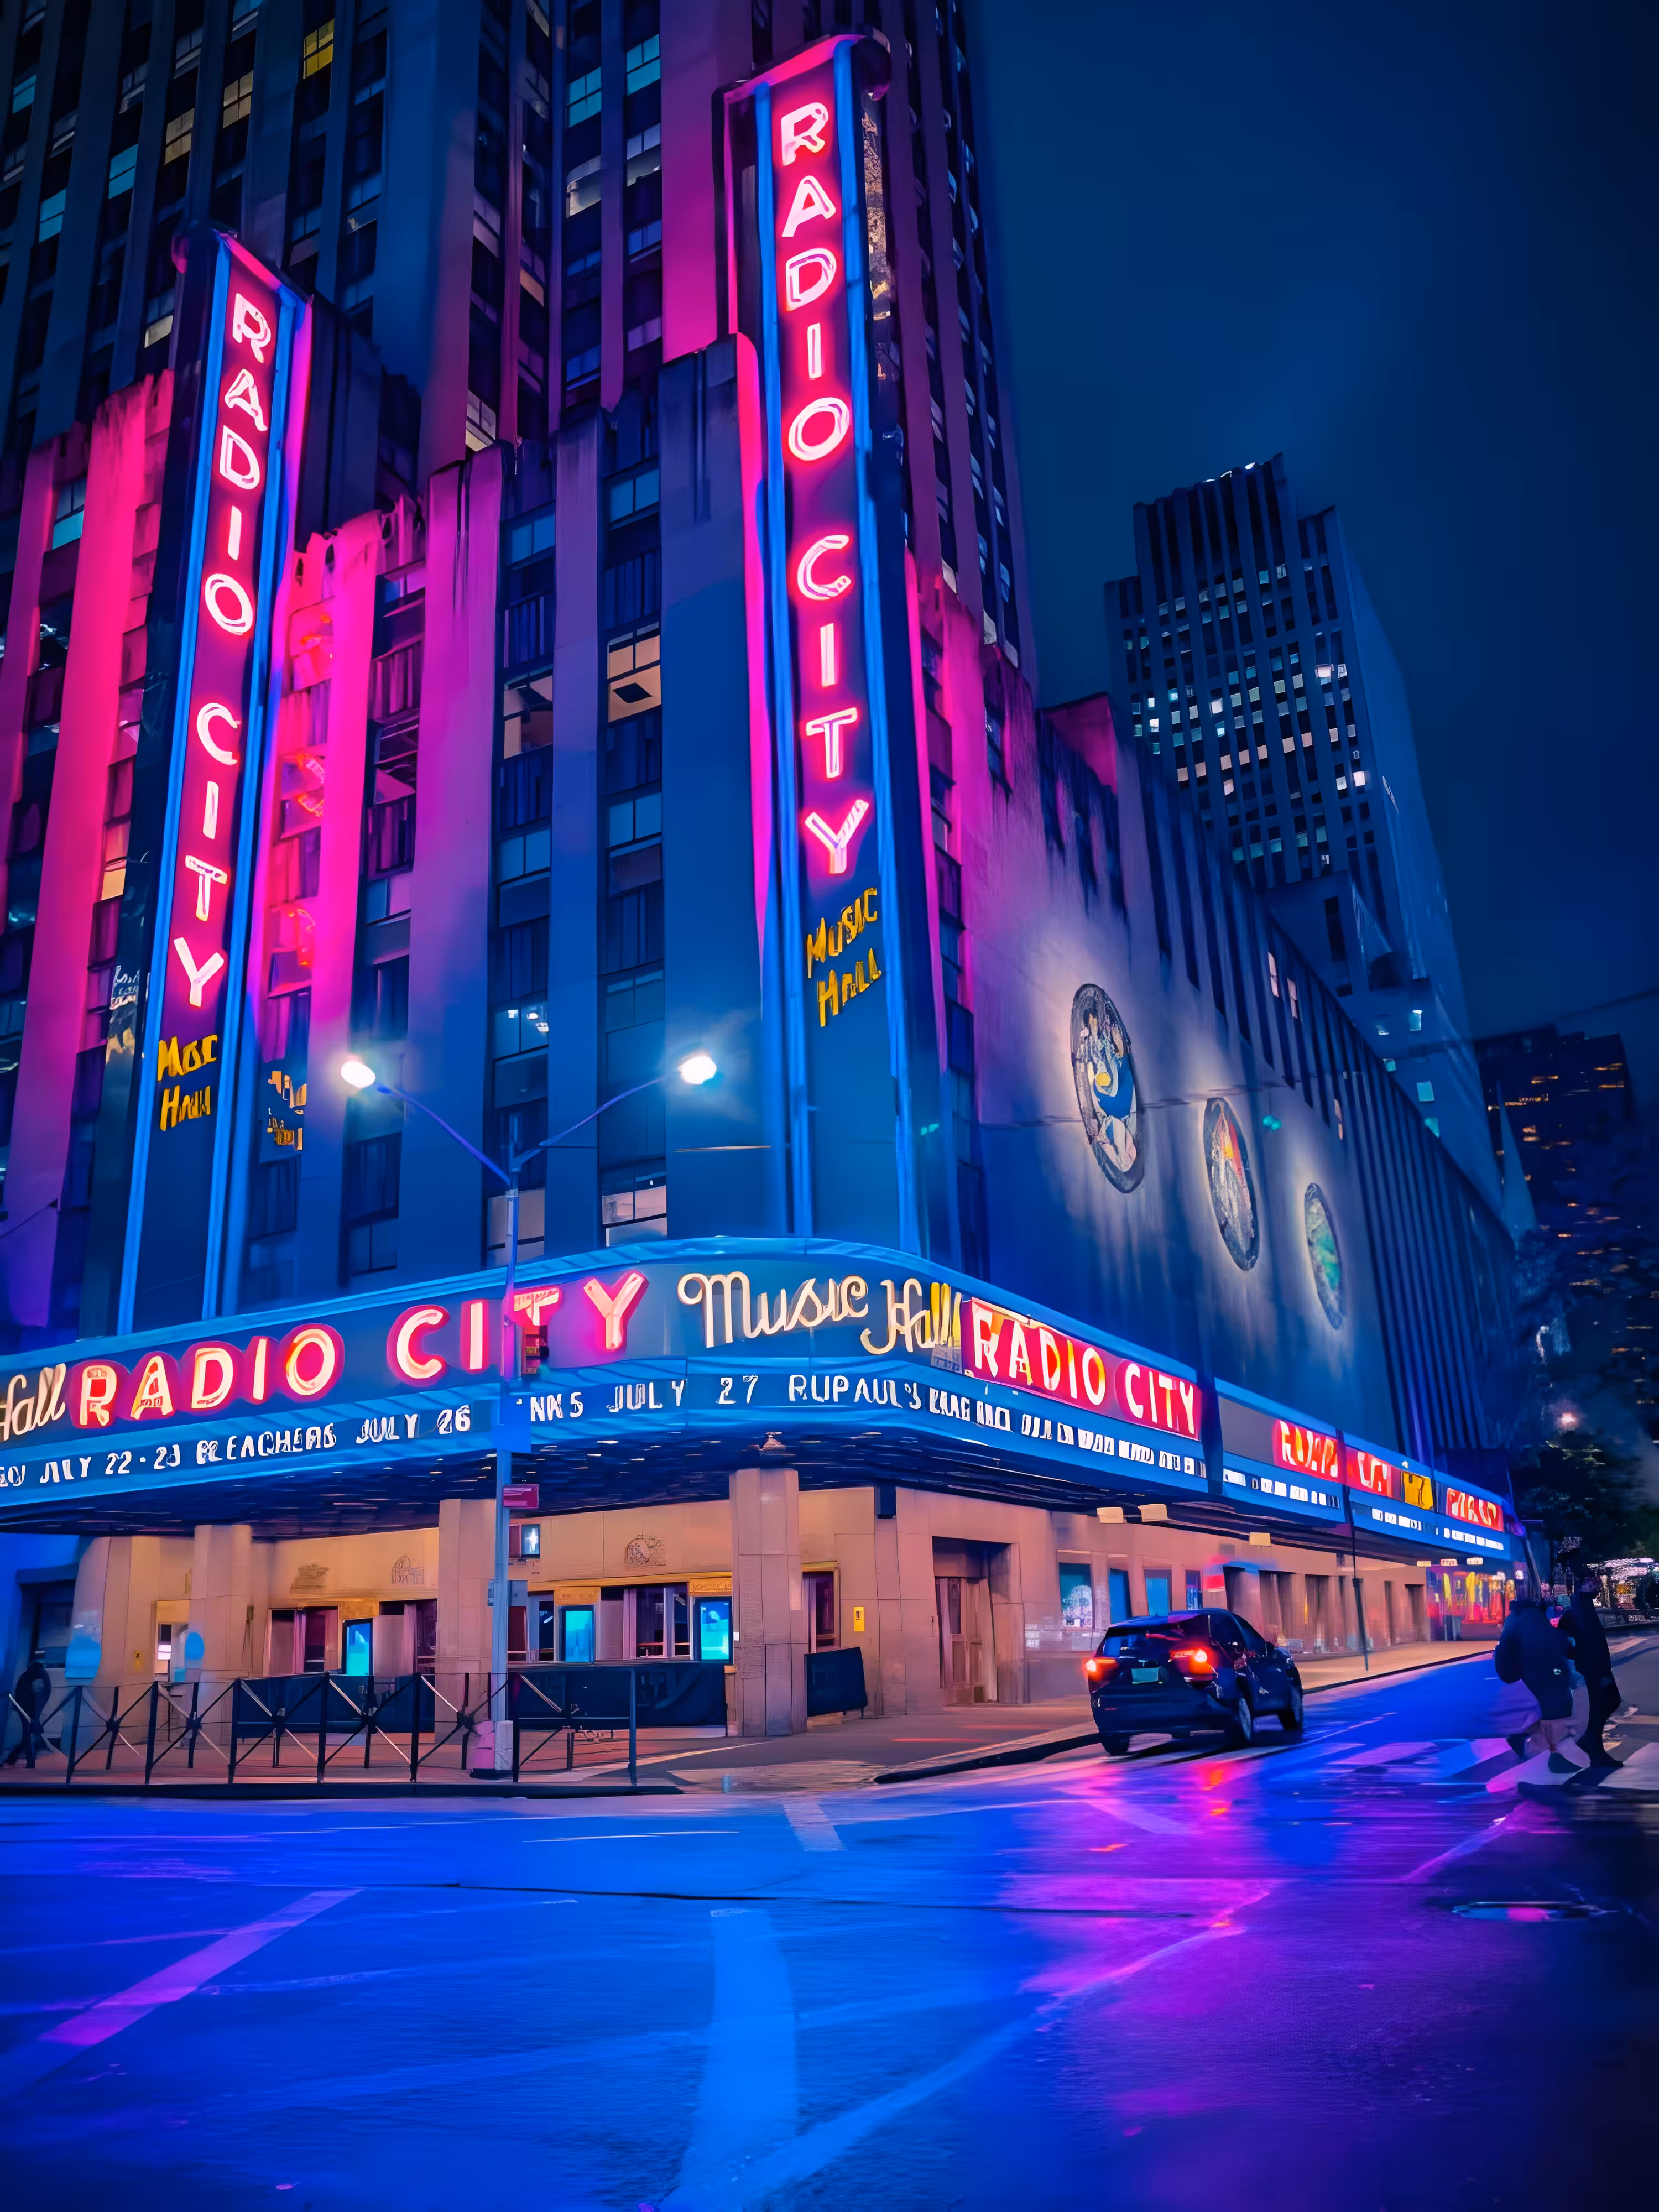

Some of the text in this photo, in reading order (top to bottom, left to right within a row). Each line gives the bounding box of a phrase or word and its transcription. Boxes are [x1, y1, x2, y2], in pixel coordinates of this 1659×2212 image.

[781, 102, 869, 874] RADIO CITY
[173, 293, 272, 1008] RADIO CITY
[79, 1272, 645, 1427] RADIO CITY
[676, 1271, 868, 1348] Music
[971, 1307, 1106, 1406] RADIO
[1124, 1363, 1195, 1436] CITY
[715, 1374, 758, 1404] 27
